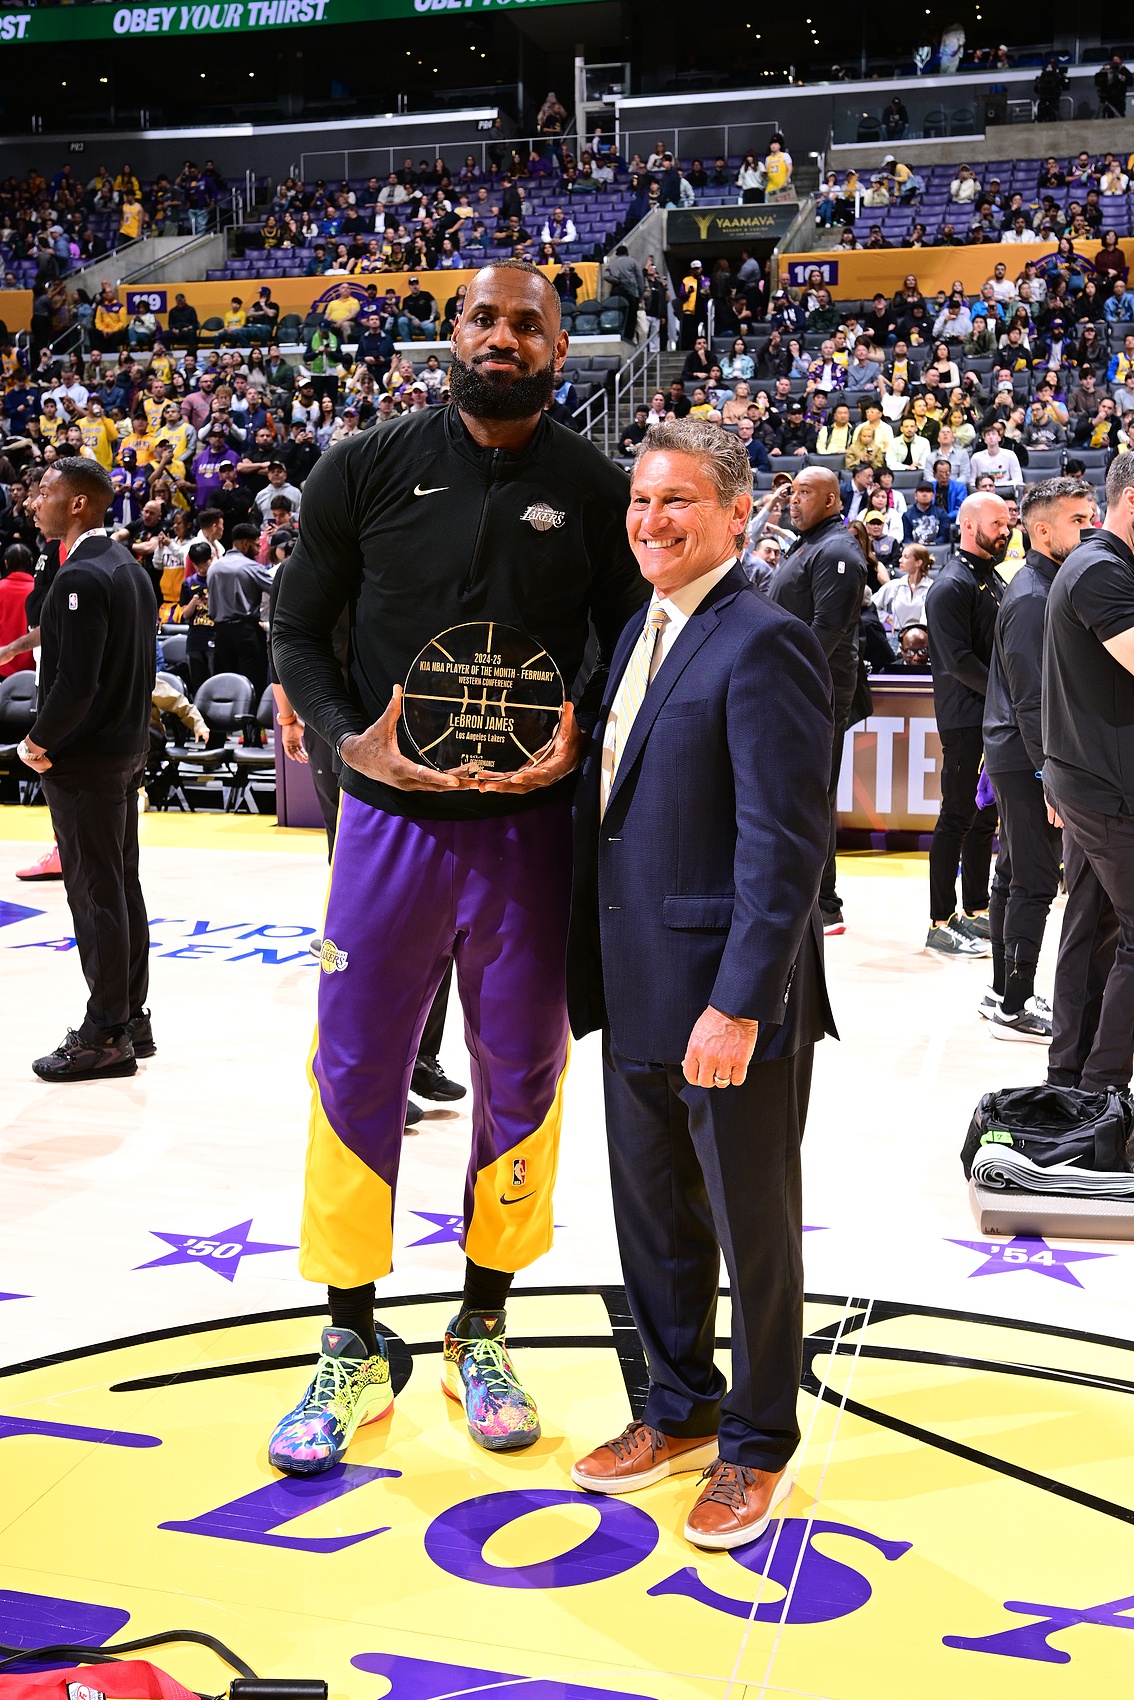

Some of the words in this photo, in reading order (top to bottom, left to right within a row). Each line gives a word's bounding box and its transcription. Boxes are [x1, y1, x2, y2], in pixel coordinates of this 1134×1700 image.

[113, 7, 177, 34] OBEY
[179, 4, 244, 30] YOUR
[84, 435, 98, 447] 23
[520, 506, 566, 528] LAKERS
[474, 653, 501, 665] 2024-25
[420, 661, 430, 671] KIA
[432, 662, 444, 672] NBA
[446, 663, 469, 675] PLAYER
[471, 665, 479, 675] OF
[481, 666, 492, 677] THE
[493, 667, 516, 678] MONTH
[521, 670, 555, 682] FEBRUARY
[458, 676, 482, 686] WESTERN
[482, 677, 513, 688] CONFERENCE
[484, 716, 515, 732] JAMES
[455, 730, 466, 739] Los
[466, 731, 487, 742] Angeles
[487, 733, 506, 744] Lakers
[984, 1226, 1002, 1234] LAL
[182, 1238, 244, 1259] '50
[990, 1245, 1056, 1267] '54
